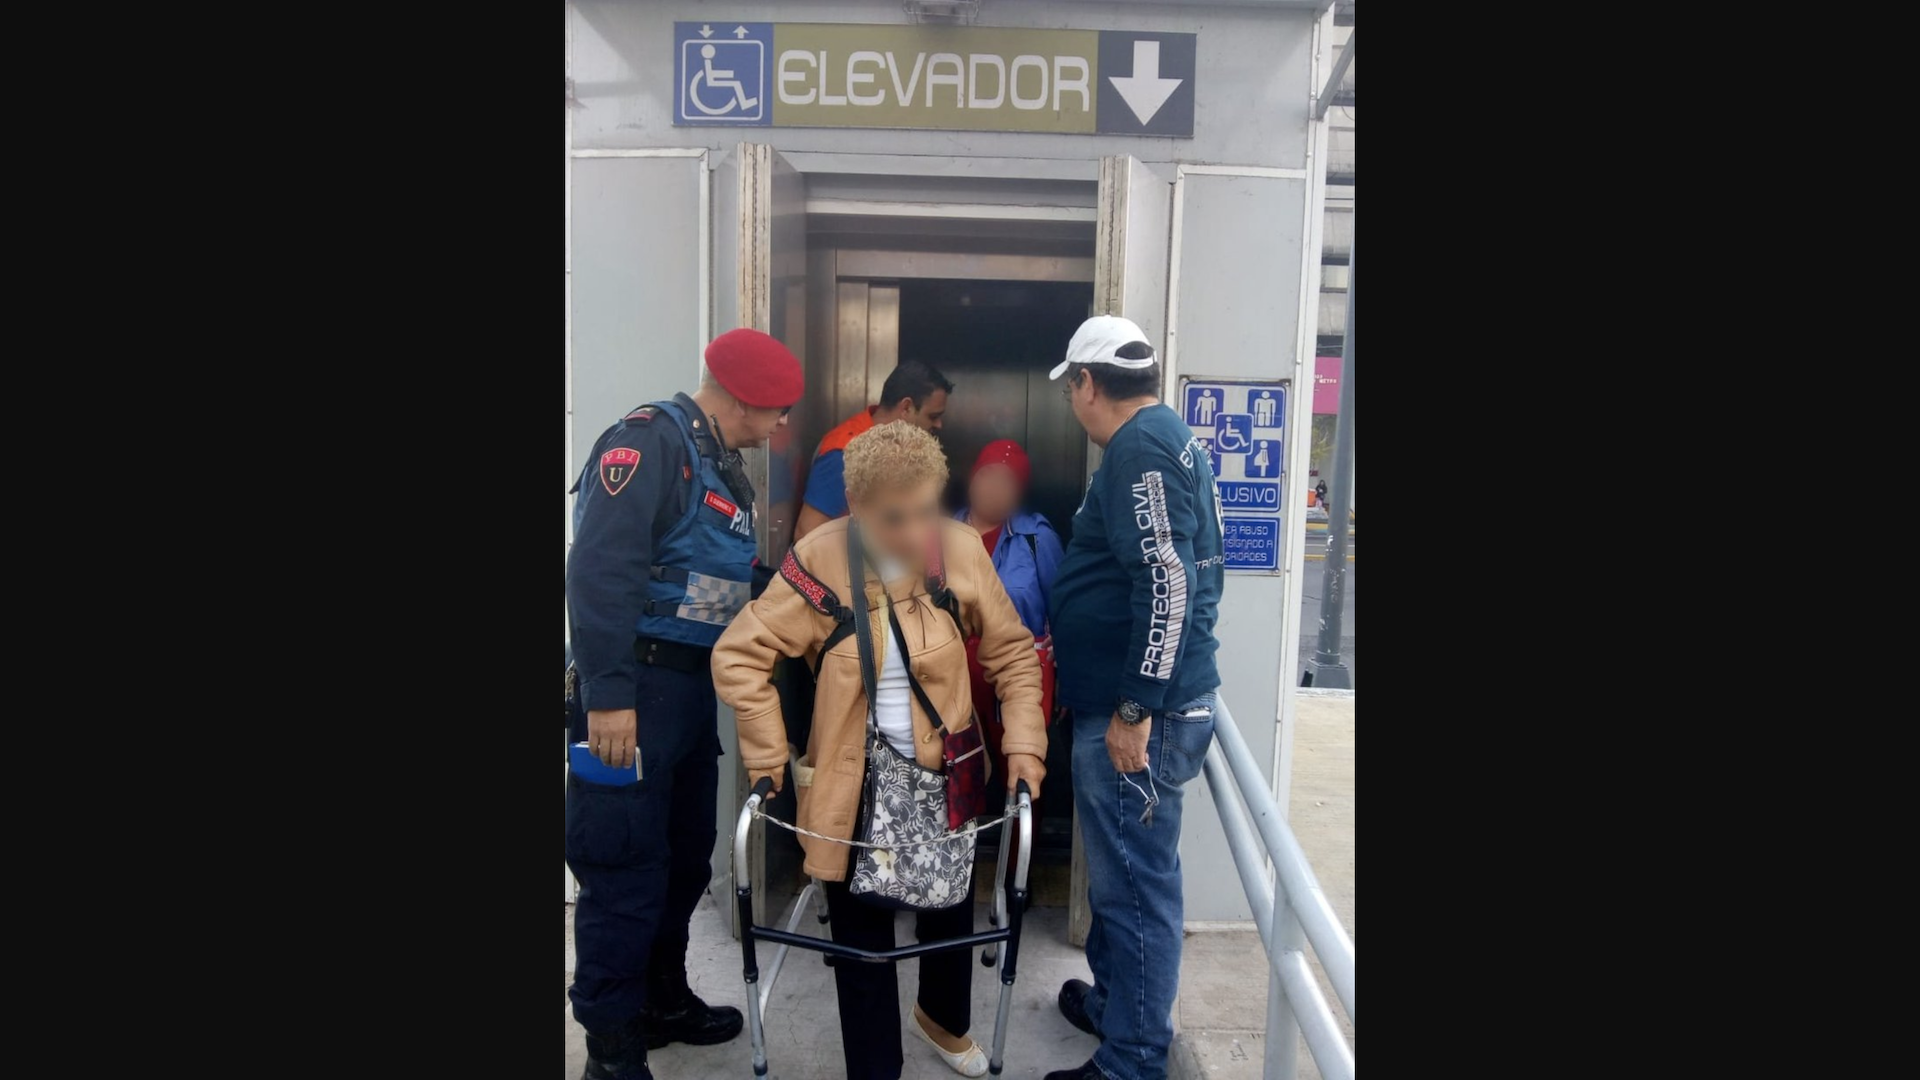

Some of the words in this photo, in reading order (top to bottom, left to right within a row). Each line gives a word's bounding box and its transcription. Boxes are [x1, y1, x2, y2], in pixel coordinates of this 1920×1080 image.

[777, 49, 1090, 112] ELEVADOR
[604, 450, 637, 463] PBI
[609, 467, 623, 482] U
[1132, 473, 1152, 530] CIVIL
[1239, 525, 1269, 536] ABUSO
[1266, 539, 1273, 549] A
